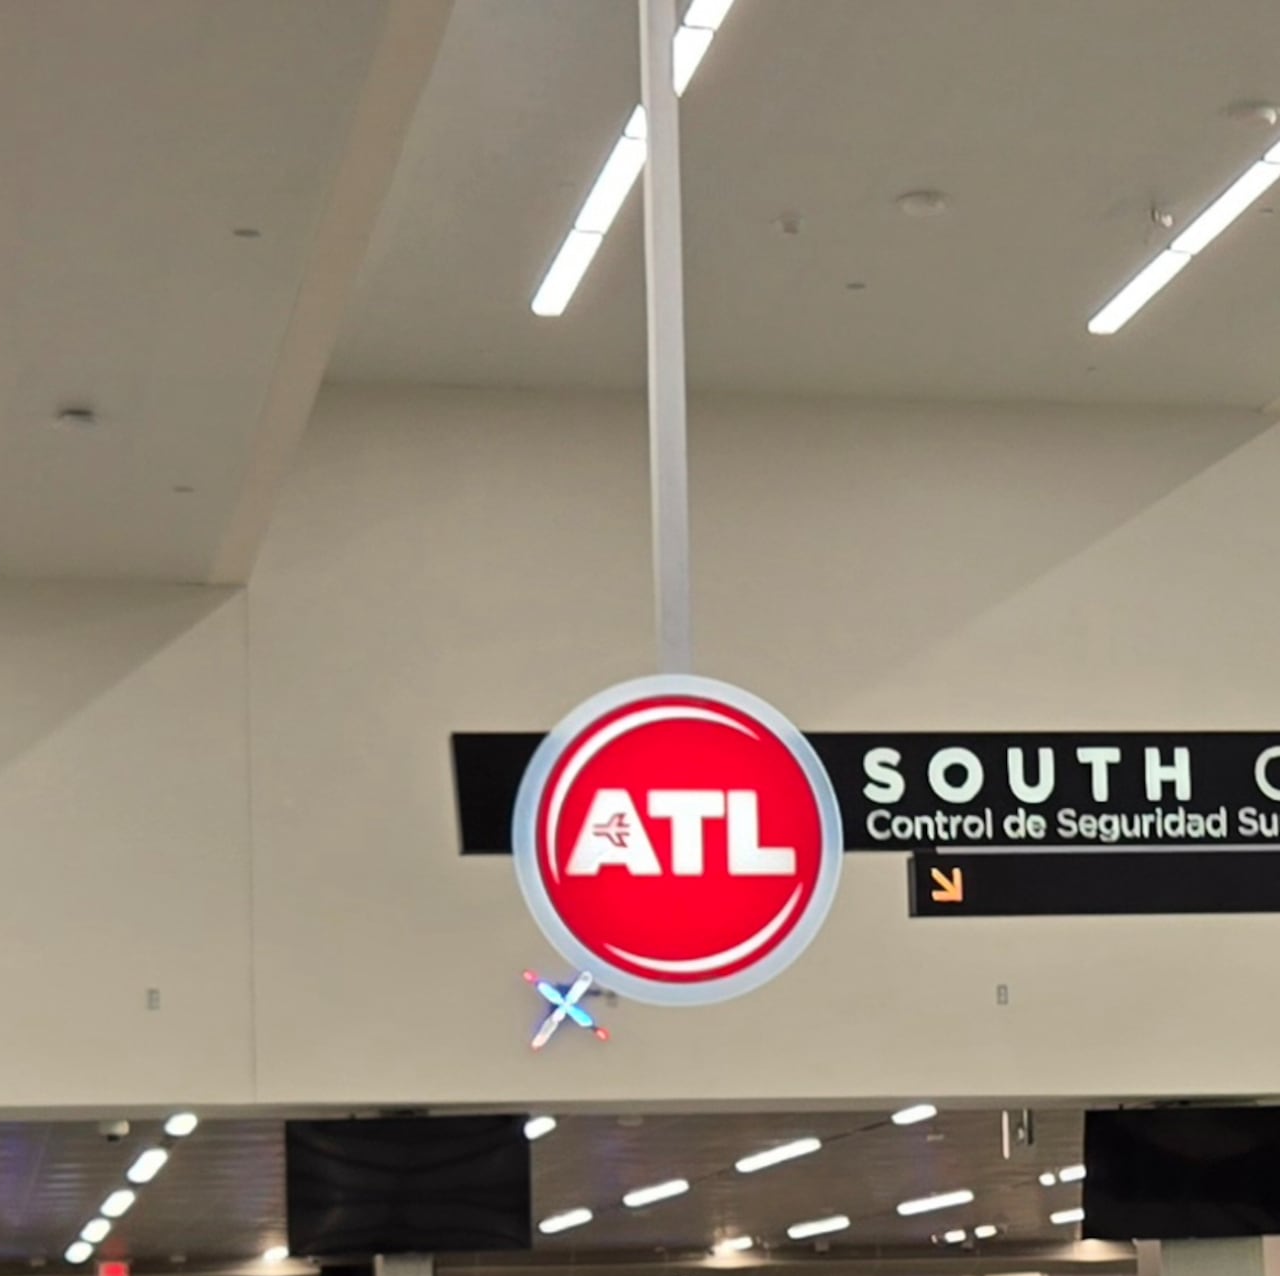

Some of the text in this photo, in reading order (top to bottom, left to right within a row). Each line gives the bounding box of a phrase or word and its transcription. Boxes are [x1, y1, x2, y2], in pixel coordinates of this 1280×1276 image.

[862, 745, 1192, 803] SOUTH
[564, 788, 797, 877] ATL
[865, 807, 993, 841] Control
[1003, 807, 1046, 840] de
[1056, 806, 1227, 844] Seguridad
